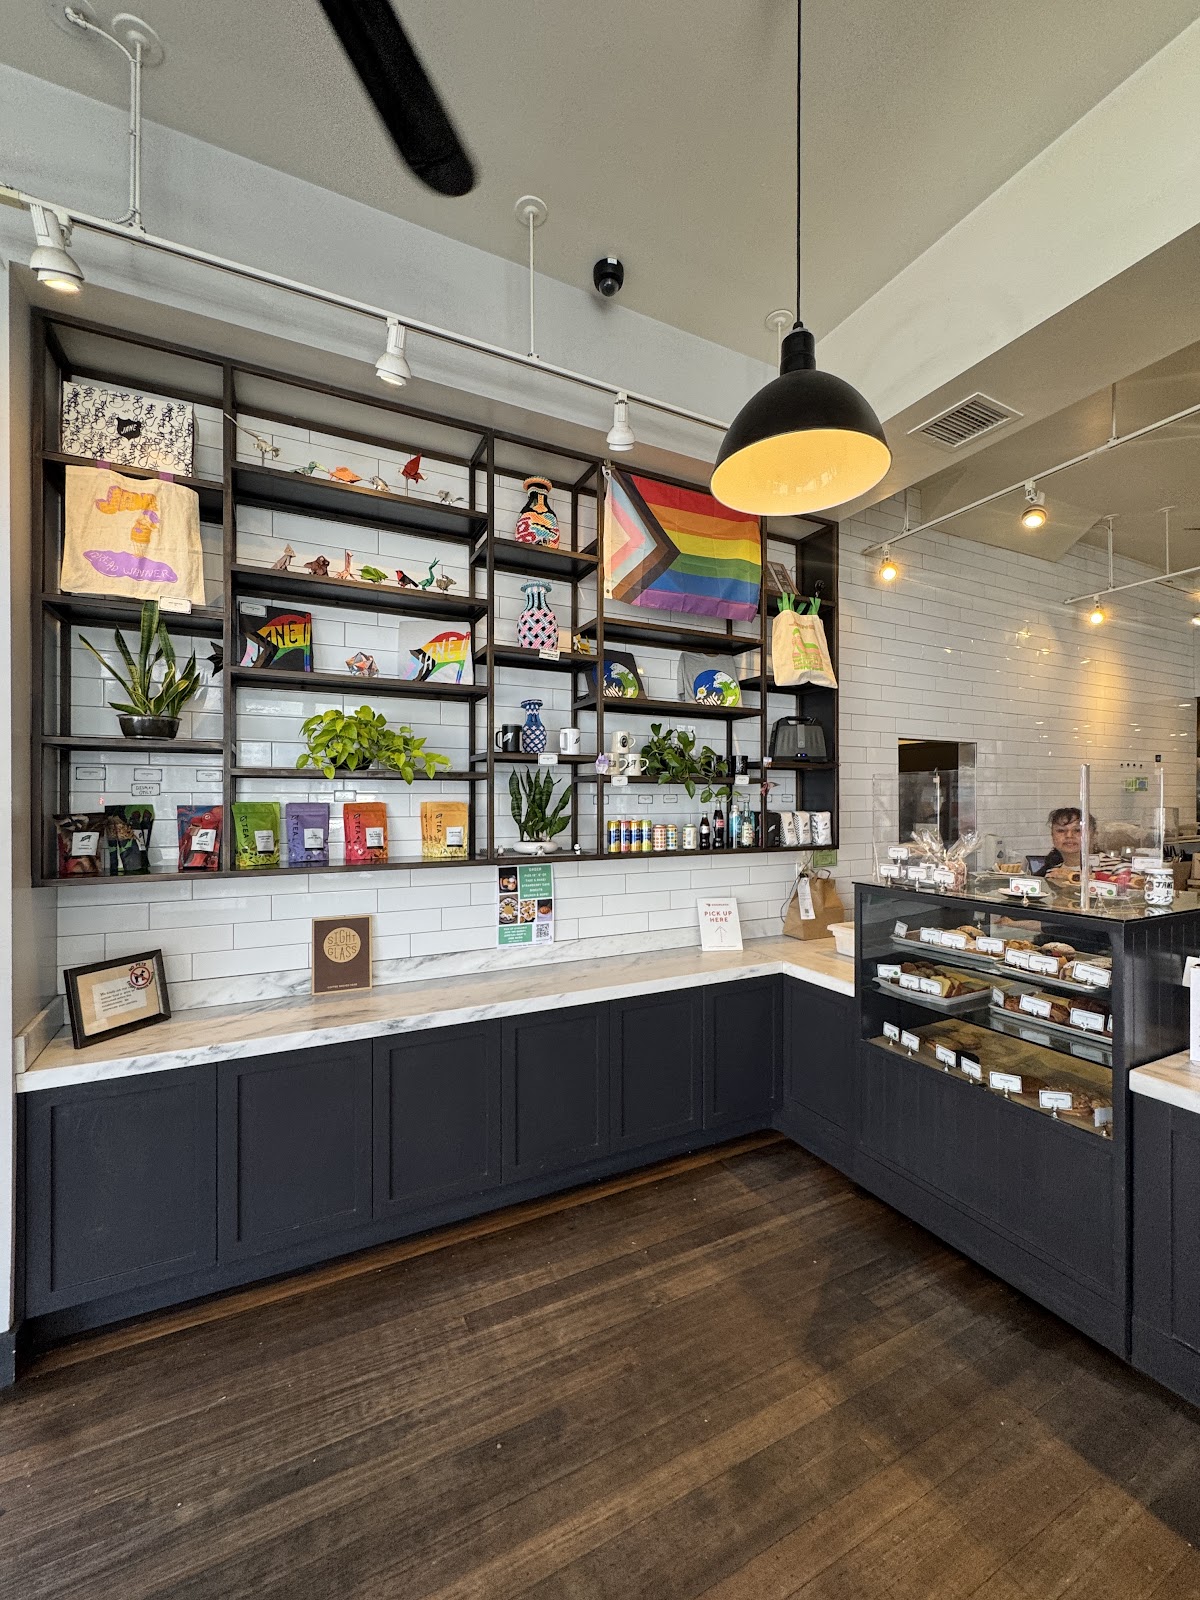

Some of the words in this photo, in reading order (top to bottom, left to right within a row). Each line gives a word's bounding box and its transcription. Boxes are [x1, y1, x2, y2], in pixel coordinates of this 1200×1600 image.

[121, 424, 138, 435] JANE
[89, 551, 118, 572] BREAD
[122, 566, 173, 579] WINNER
[328, 930, 356, 944] SIGHT
[328, 945, 357, 960] GLASS
